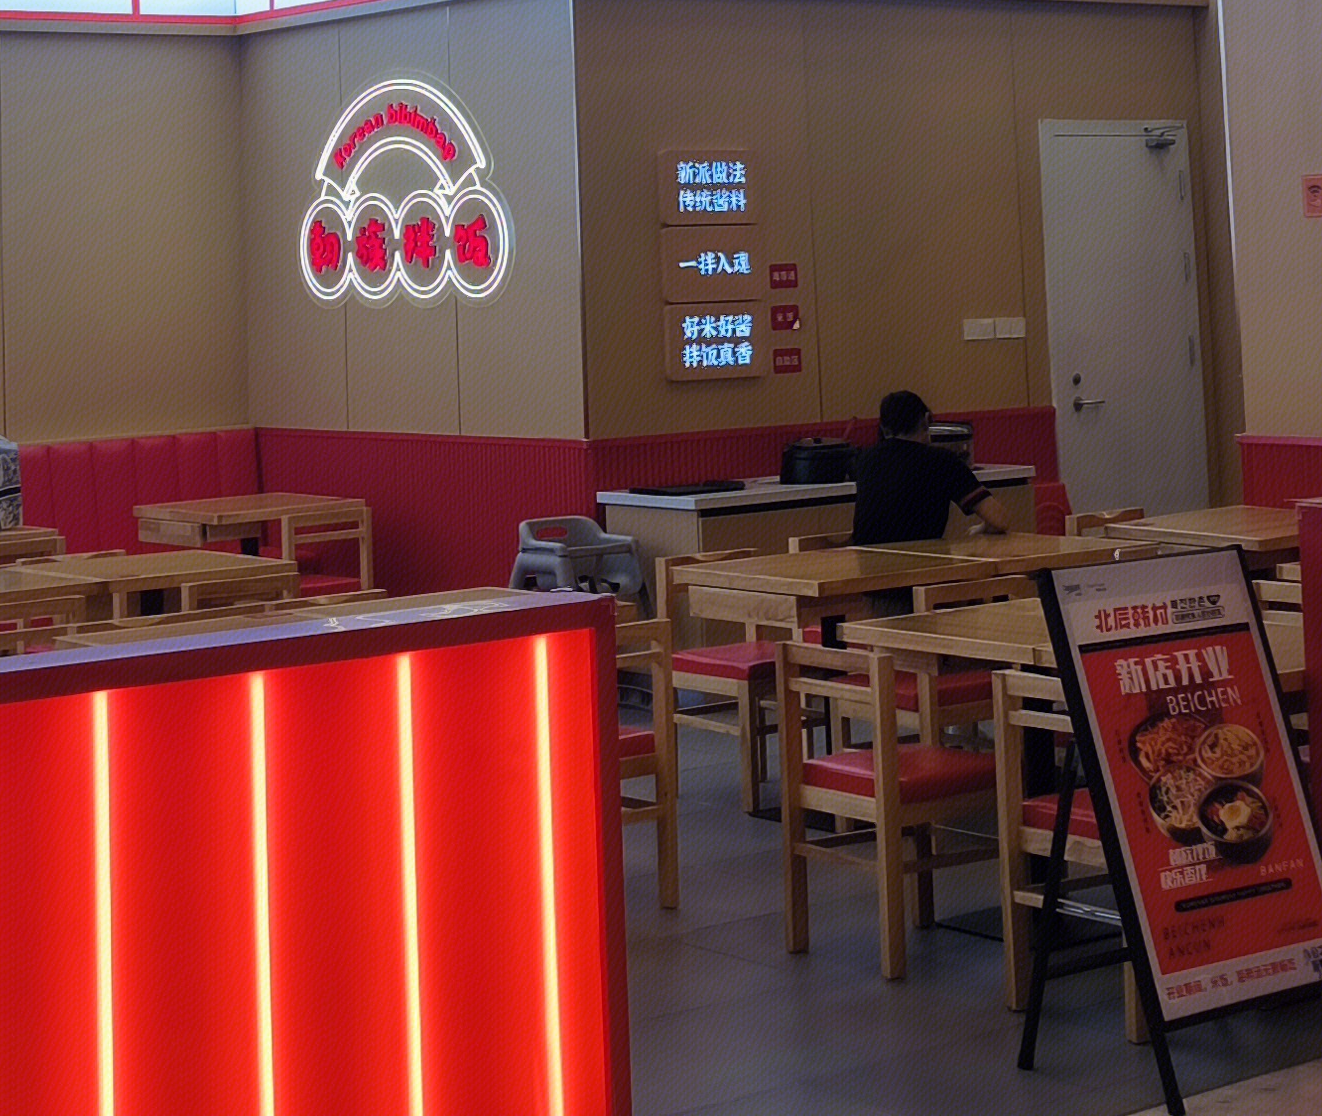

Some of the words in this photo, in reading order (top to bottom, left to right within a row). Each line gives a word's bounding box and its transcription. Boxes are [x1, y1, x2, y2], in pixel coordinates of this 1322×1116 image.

[676, 161, 747, 184] 新派做法
[678, 189, 747, 213] 传统酱料
[682, 314, 753, 339] 好米好酱
[681, 342, 753, 368] 拌饭真香
[1093, 601, 1169, 634] 北辰韩村
[1114, 645, 1234, 695] 新店开业
[1166, 685, 1242, 716] BEICHEN
[1259, 858, 1304, 876] BANFAN
